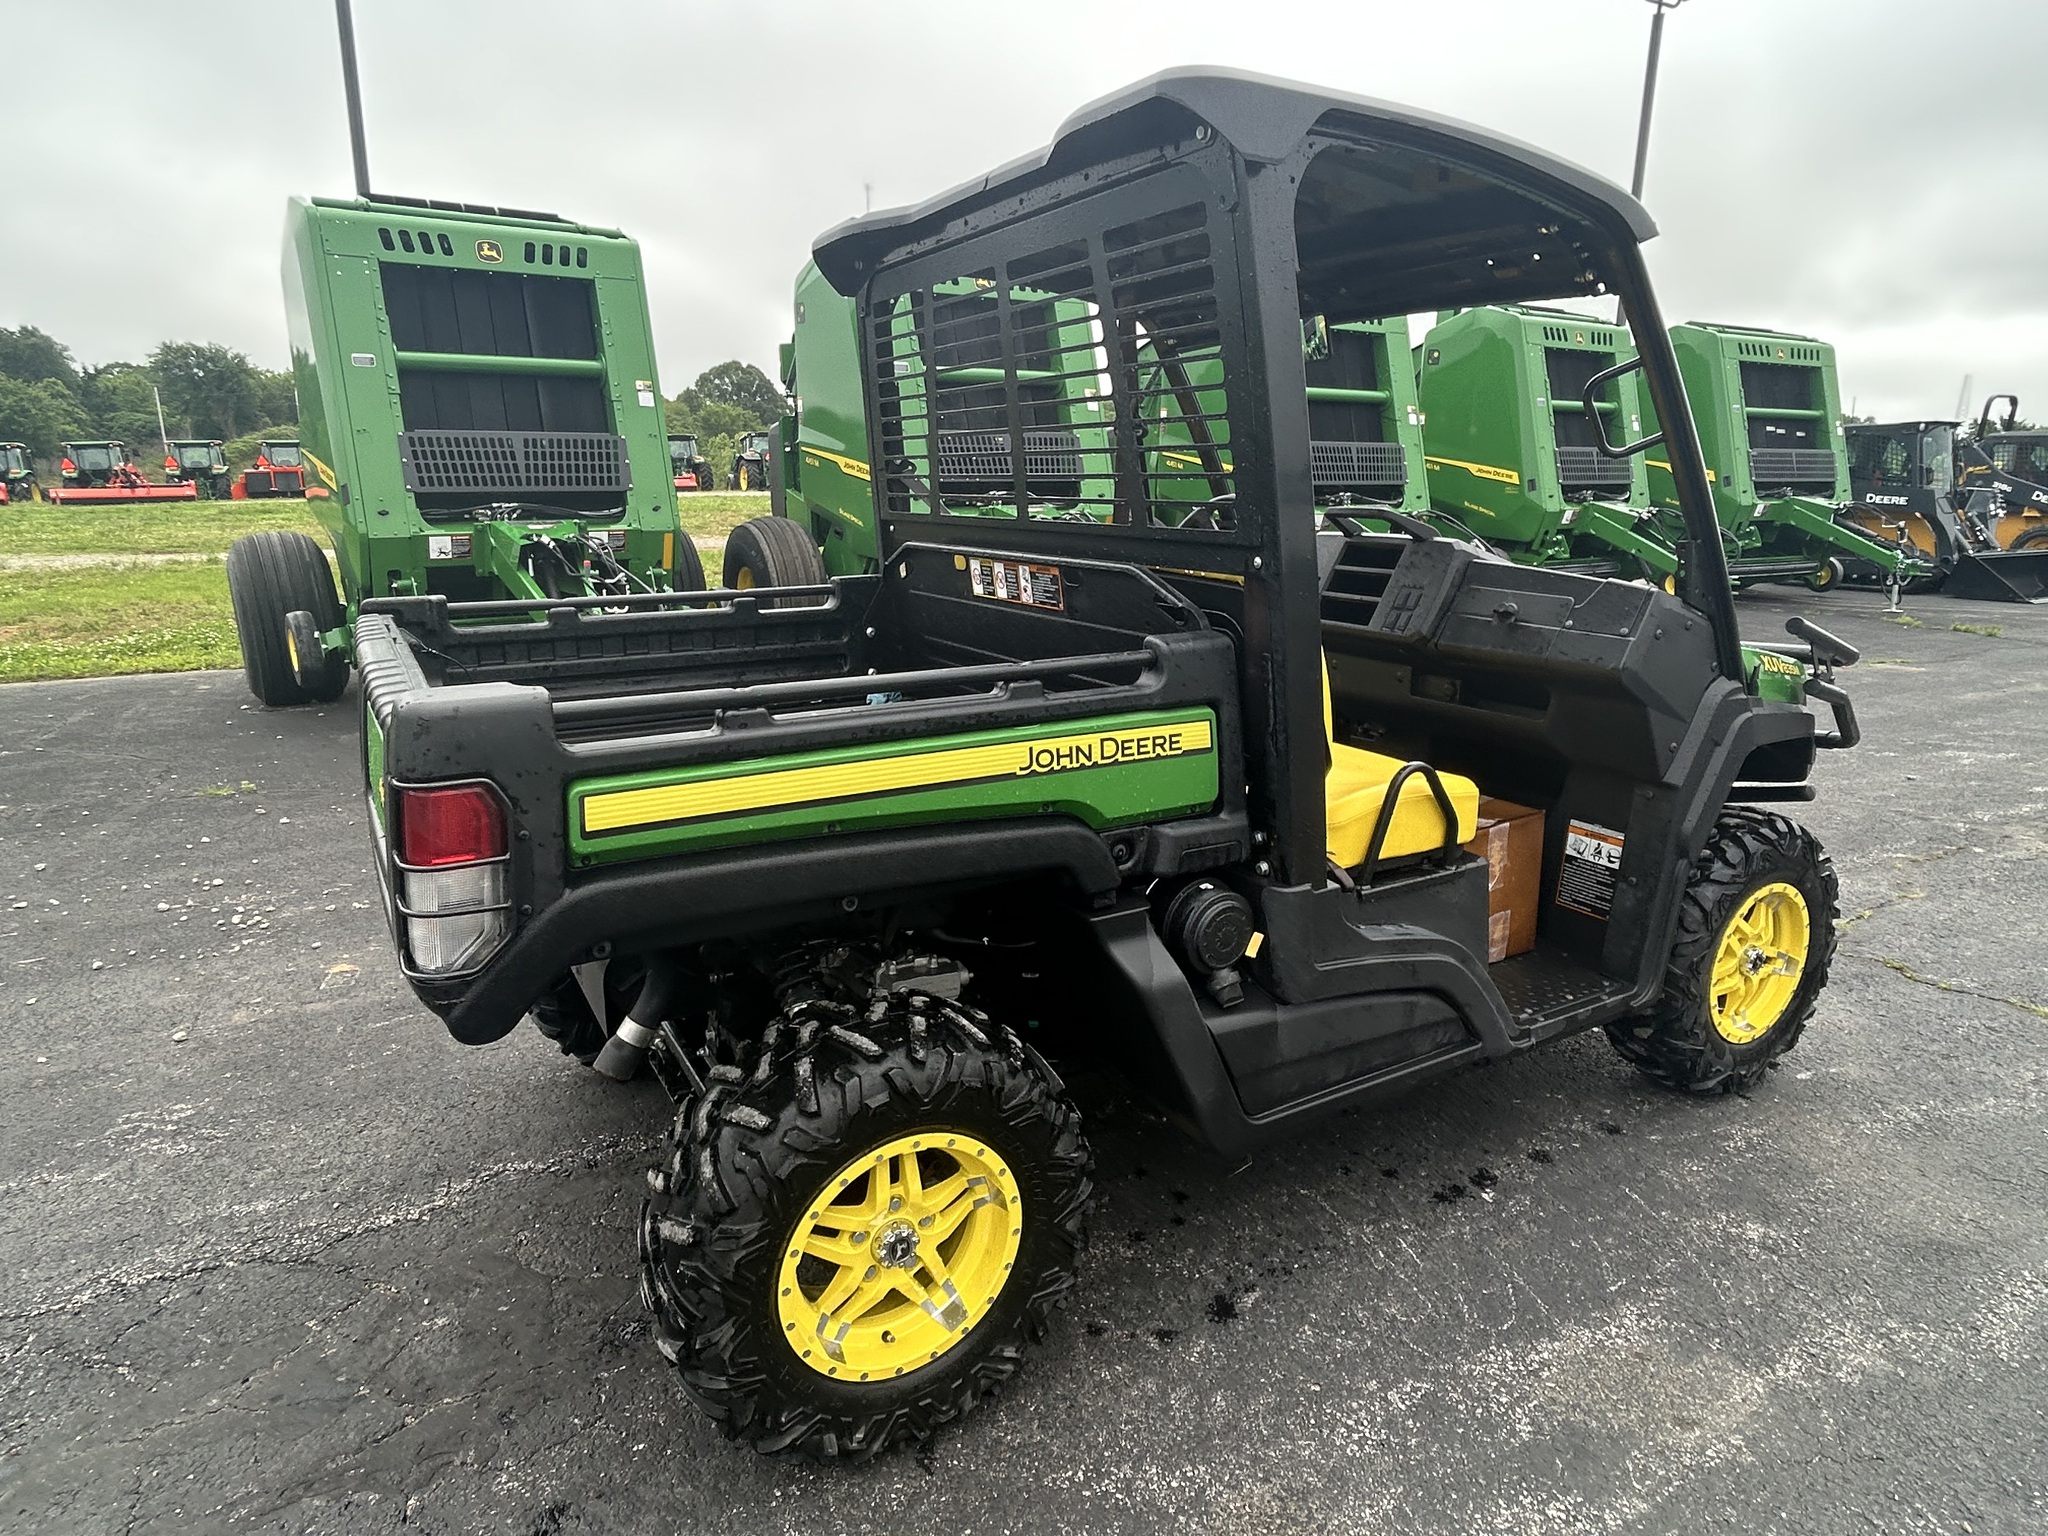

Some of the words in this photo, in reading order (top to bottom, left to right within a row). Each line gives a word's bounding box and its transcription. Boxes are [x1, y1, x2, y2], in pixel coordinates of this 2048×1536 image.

[856, 464, 870, 475] DEER
[1475, 467, 1492, 476] JOHN
[1493, 470, 1514, 480] DEERE
[1865, 493, 1909, 506] DEERE
[1019, 743, 1093, 772] JOHN
[1100, 733, 1183, 761] DEERE
